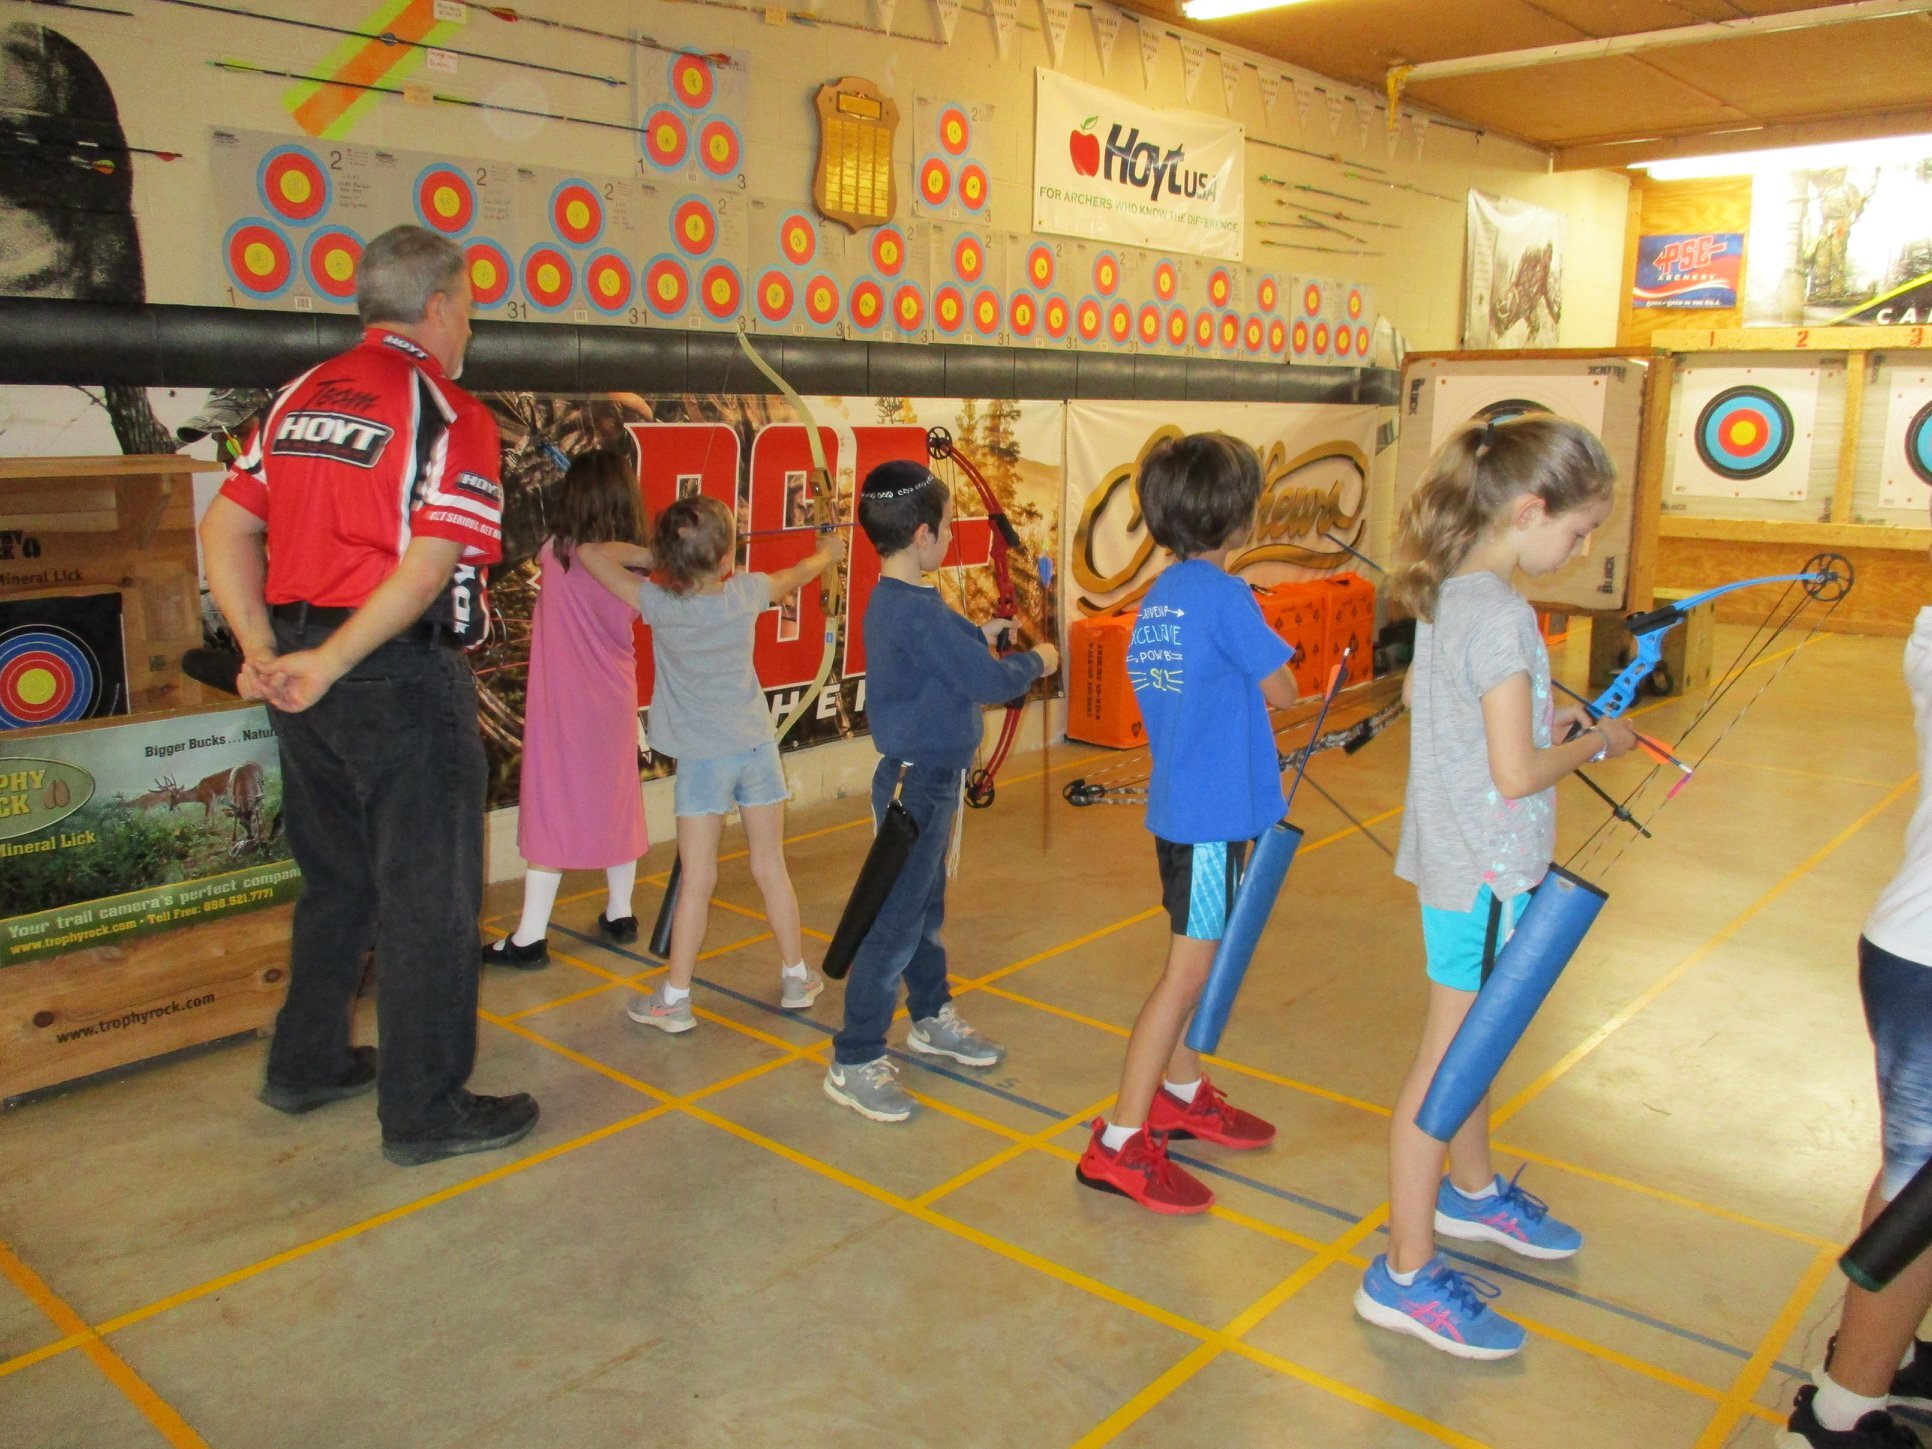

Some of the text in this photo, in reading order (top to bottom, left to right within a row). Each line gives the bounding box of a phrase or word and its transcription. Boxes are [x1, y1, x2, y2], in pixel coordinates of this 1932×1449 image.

[329, 150, 343, 171] 2
[476, 167, 487, 186] 2
[737, 173, 747, 190] 3
[604, 183, 614, 200] 2
[1039, 186, 1061, 200] FOR
[1064, 191, 1113, 210] ARCHERS
[1115, 200, 1138, 214] WHO
[1139, 206, 1168, 219] KNOW
[1169, 210, 1186, 223] THE
[1652, 234, 1727, 275] PSE
[1876, 306, 1932, 325] CA
[1709, 330, 1715, 347] 1
[1796, 330, 1809, 348] 2
[1910, 327, 1923, 346] 3
[383, 335, 427, 359] HOYT
[276, 415, 388, 451] HOYT
[462, 473, 500, 496] HOY
[480, 524, 493, 537] GET
[145, 743, 186, 758] Bigger
[60, 830, 97, 849] Lick
[8, 921, 50, 938] Your
[57, 909, 93, 929] trail
[99, 893, 174, 919] camera's
[180, 879, 237, 905] perfect
[10, 919, 137, 954] www.trophyrock.com
[147, 909, 171, 924] Toll
[55, 993, 215, 1044] www.trophyrock.com
